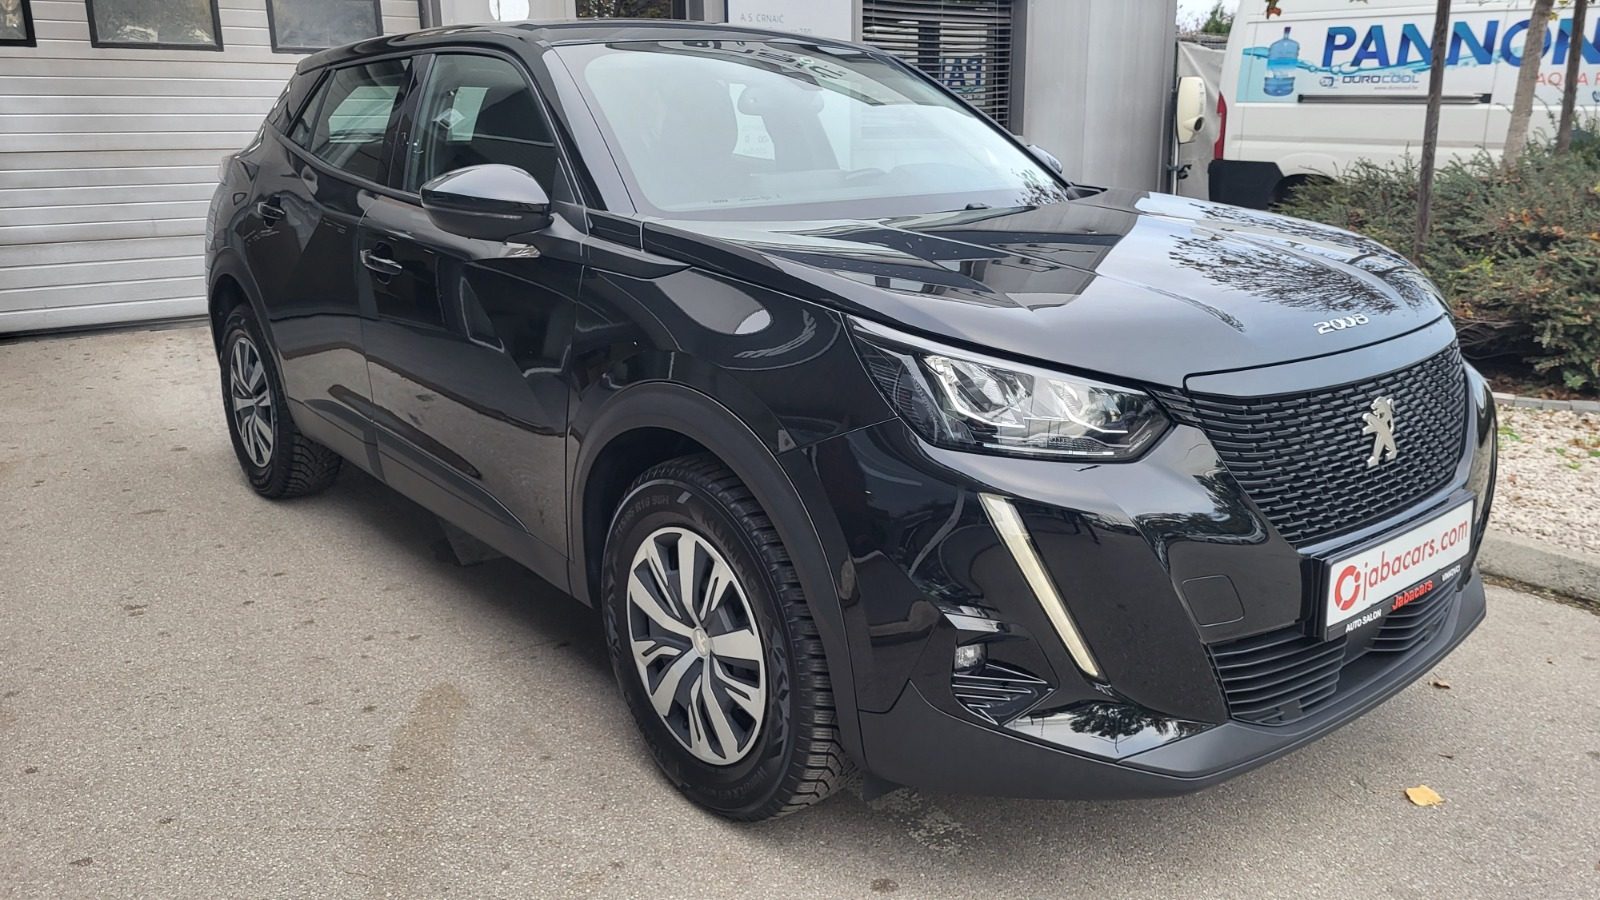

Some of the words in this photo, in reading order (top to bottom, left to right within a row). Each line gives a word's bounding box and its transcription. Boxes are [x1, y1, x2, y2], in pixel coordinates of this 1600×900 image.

[1341, 74, 1419, 84] DUROCOOL
[1535, 71, 1589, 87] AQA
[1313, 312, 1369, 335] 2008
[1362, 520, 1469, 601] jabacars.com
[1391, 580, 1434, 611] Jabacars
